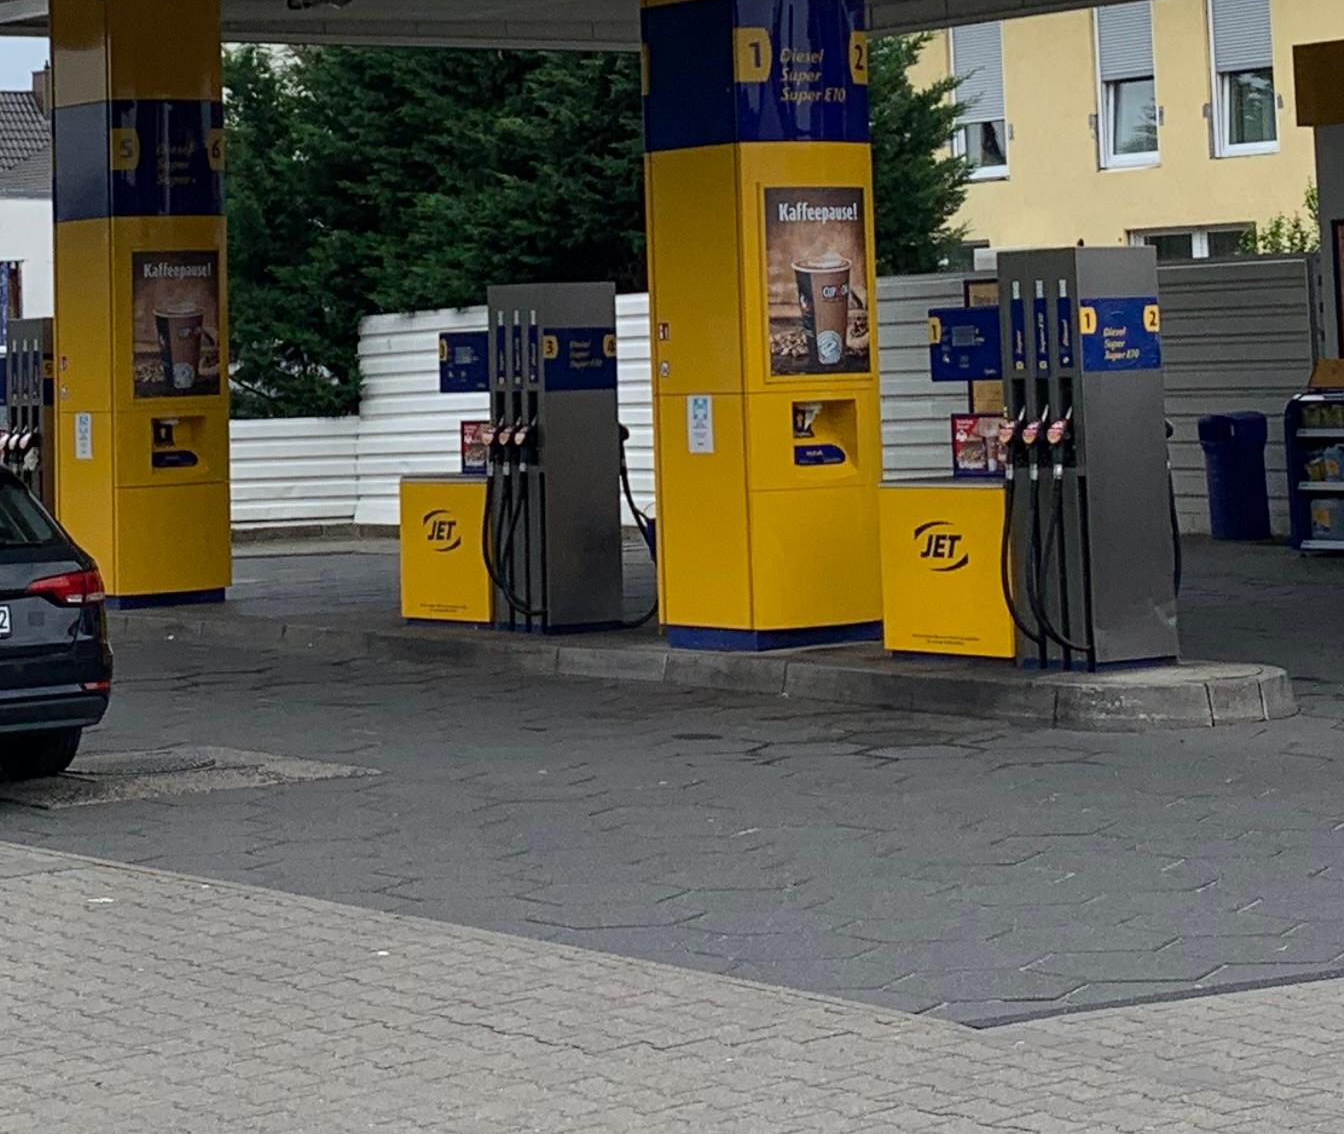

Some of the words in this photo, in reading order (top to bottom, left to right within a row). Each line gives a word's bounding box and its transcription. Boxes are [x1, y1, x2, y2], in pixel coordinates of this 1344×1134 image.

[749, 42, 761, 68] 1
[780, 48, 824, 63] Diesel
[854, 44, 864, 71] 2
[780, 67, 822, 86] Super
[780, 87, 822, 107] Super
[823, 87, 846, 103] E10
[778, 201, 858, 224] Kaffeepause!
[427, 520, 457, 540] JET
[920, 534, 962, 559] JET
